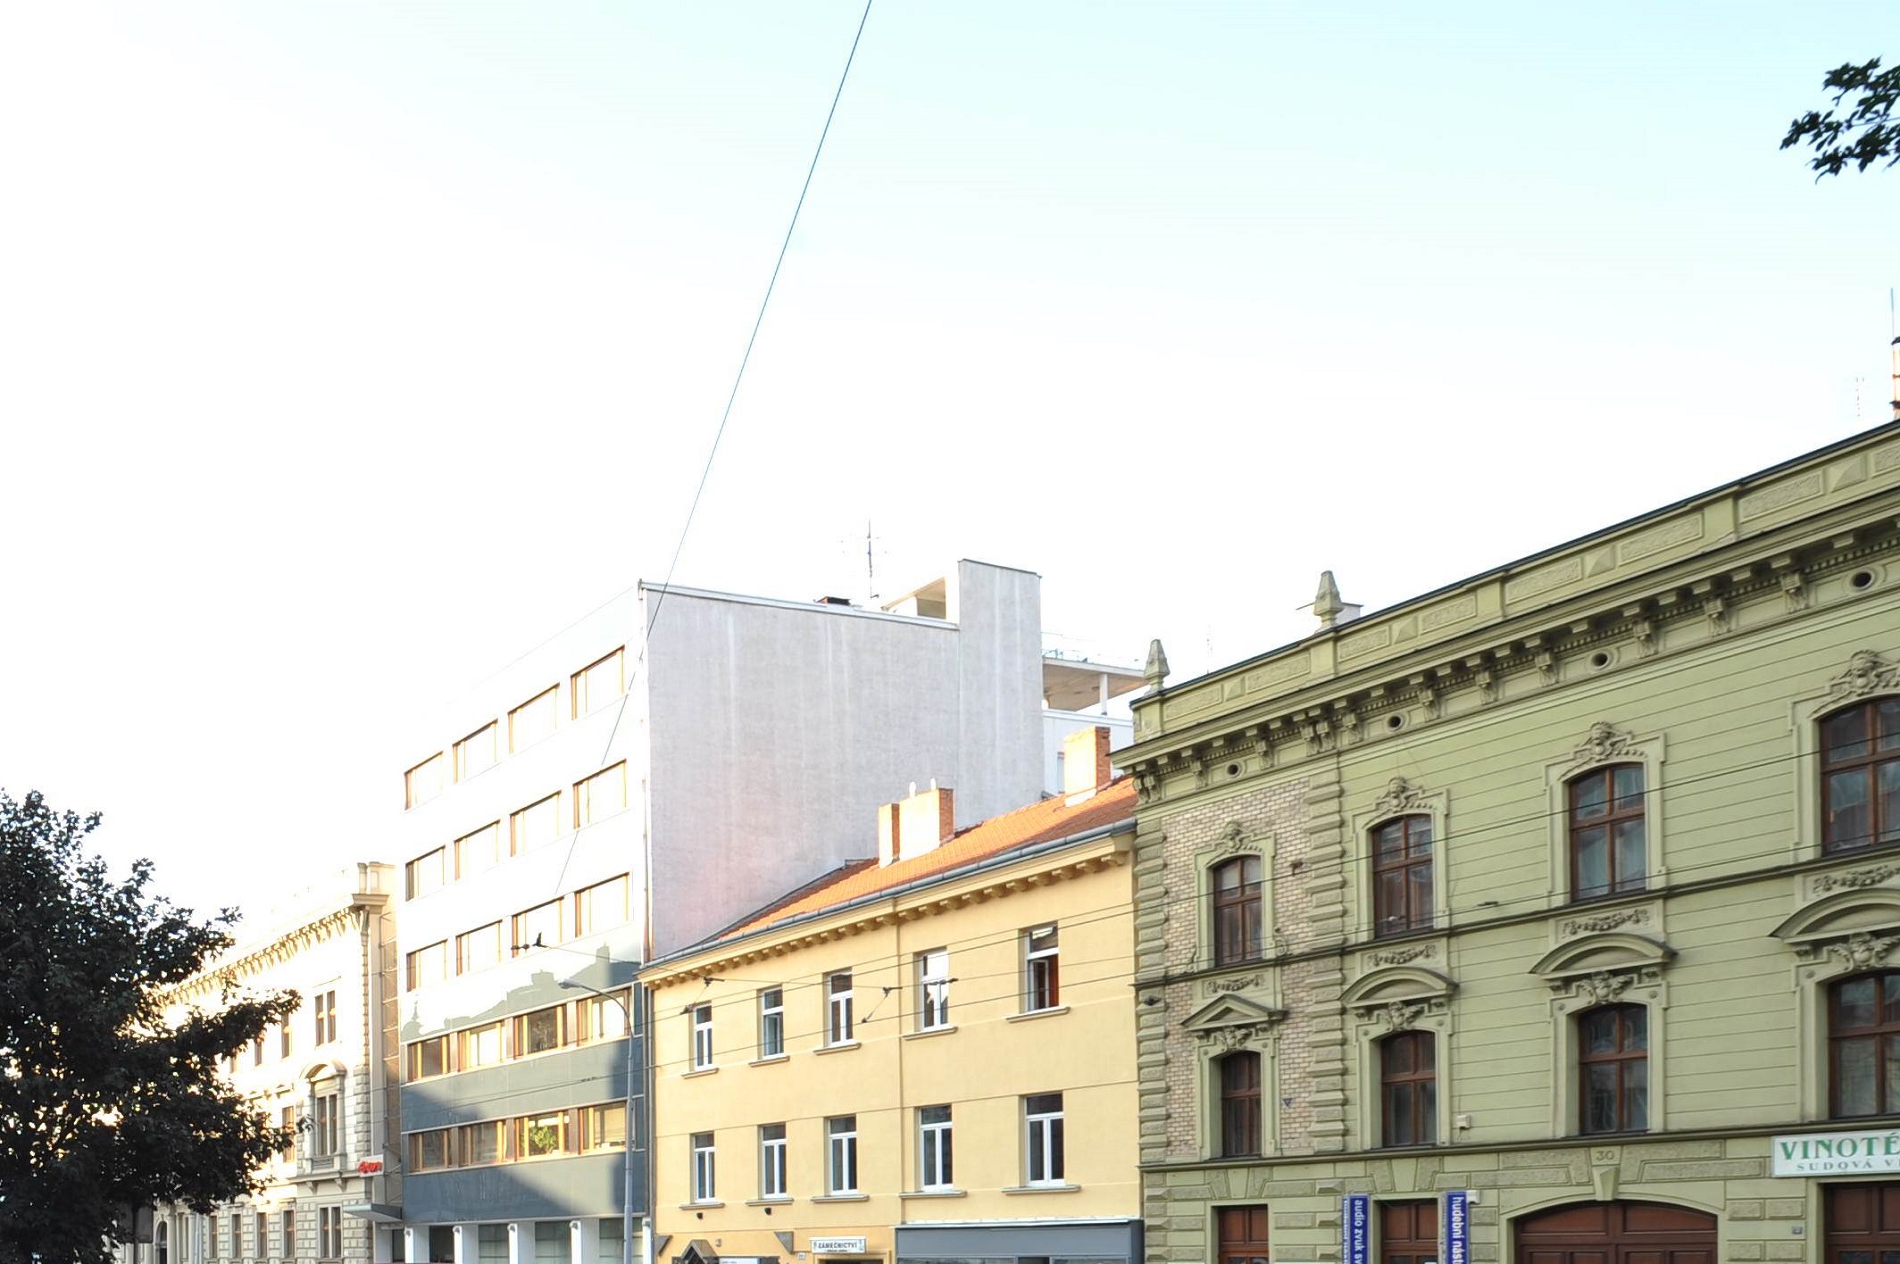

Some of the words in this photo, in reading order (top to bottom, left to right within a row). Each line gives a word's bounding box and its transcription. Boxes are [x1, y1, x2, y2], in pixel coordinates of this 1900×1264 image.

[1596, 1150, 1615, 1161] 30
[1797, 1158, 1873, 1172] SUDOVÁ
[1354, 1199, 1365, 1227] audio
[1452, 1196, 1465, 1239] hudební
[1354, 1228, 1365, 1251] zvuk
